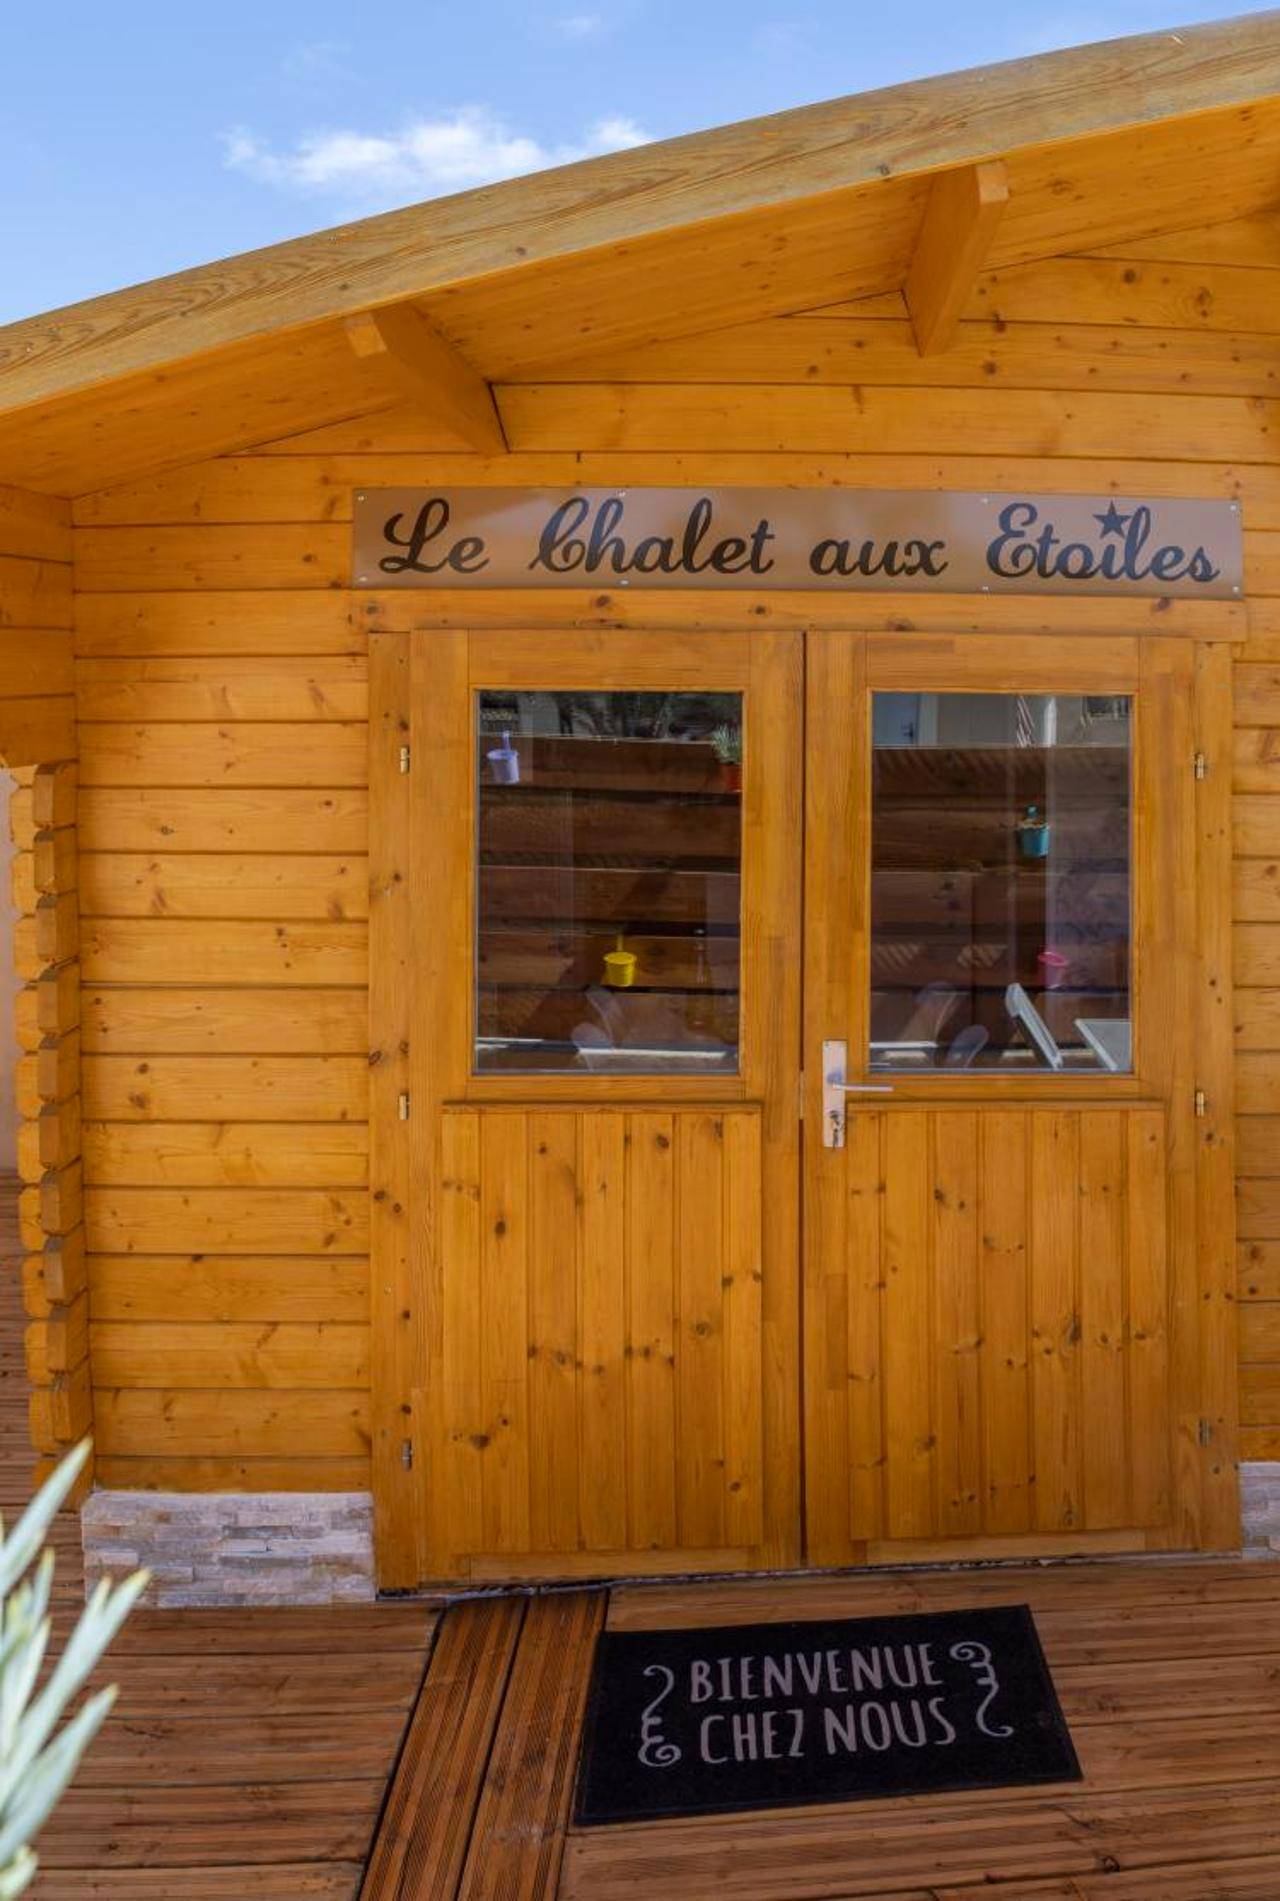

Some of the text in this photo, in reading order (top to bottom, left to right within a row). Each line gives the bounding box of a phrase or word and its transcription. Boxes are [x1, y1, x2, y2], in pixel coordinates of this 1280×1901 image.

[377, 497, 1220, 583] Le Chalet aux Etoiles
[690, 1642, 943, 1703] BIENVENUE
[700, 1698, 956, 1764] CHEZ NOUS
